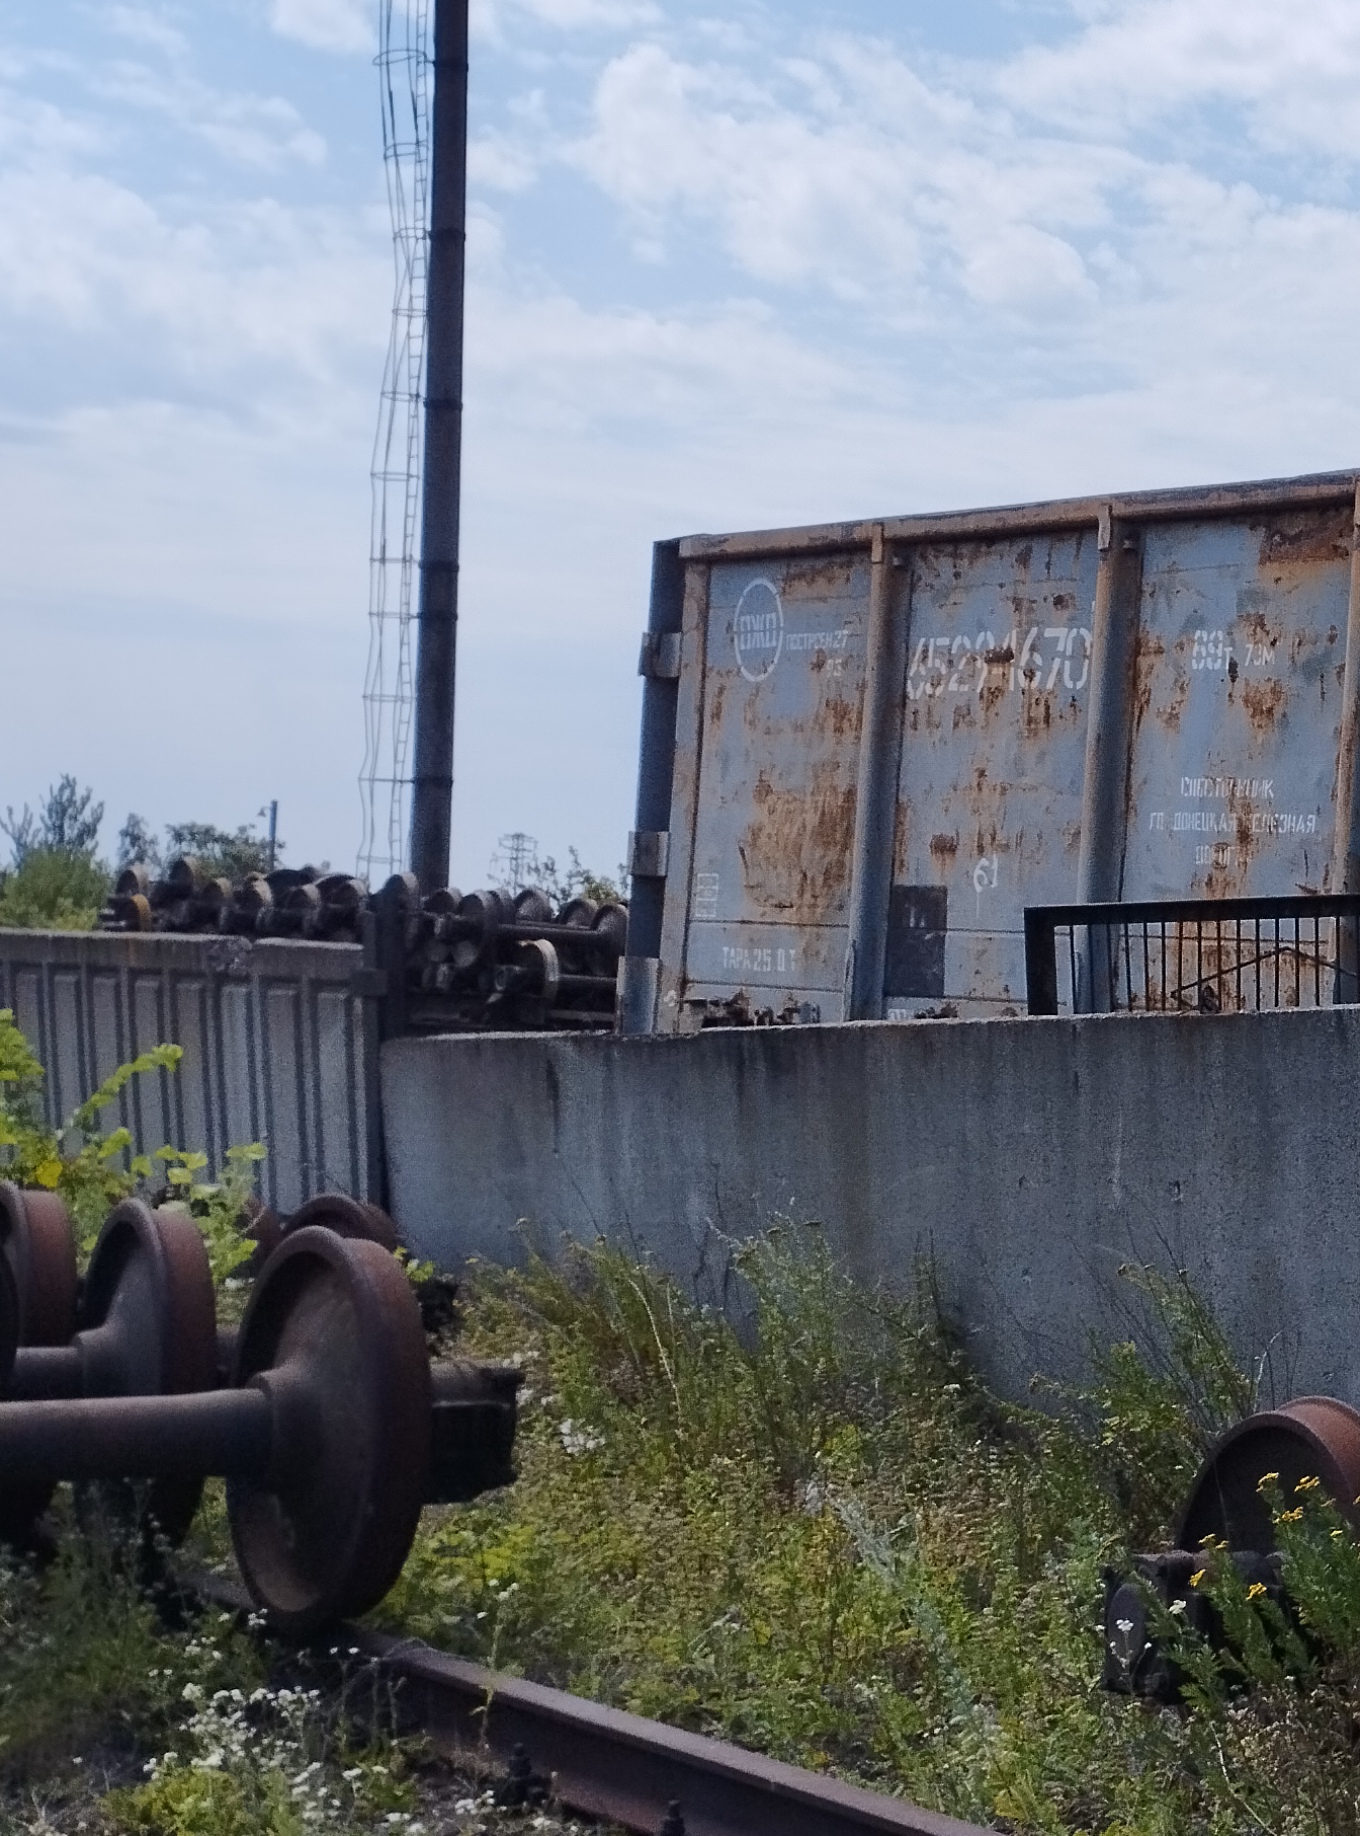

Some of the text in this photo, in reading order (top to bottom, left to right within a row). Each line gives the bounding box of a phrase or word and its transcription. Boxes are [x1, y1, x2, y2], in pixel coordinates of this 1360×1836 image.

[1173, 811, 1237, 832] ДОНЕЦКАЯ
[1240, 812, 1316, 834] ЕЛЕЗНАЯ
[722, 946, 750, 970] ТАРА
